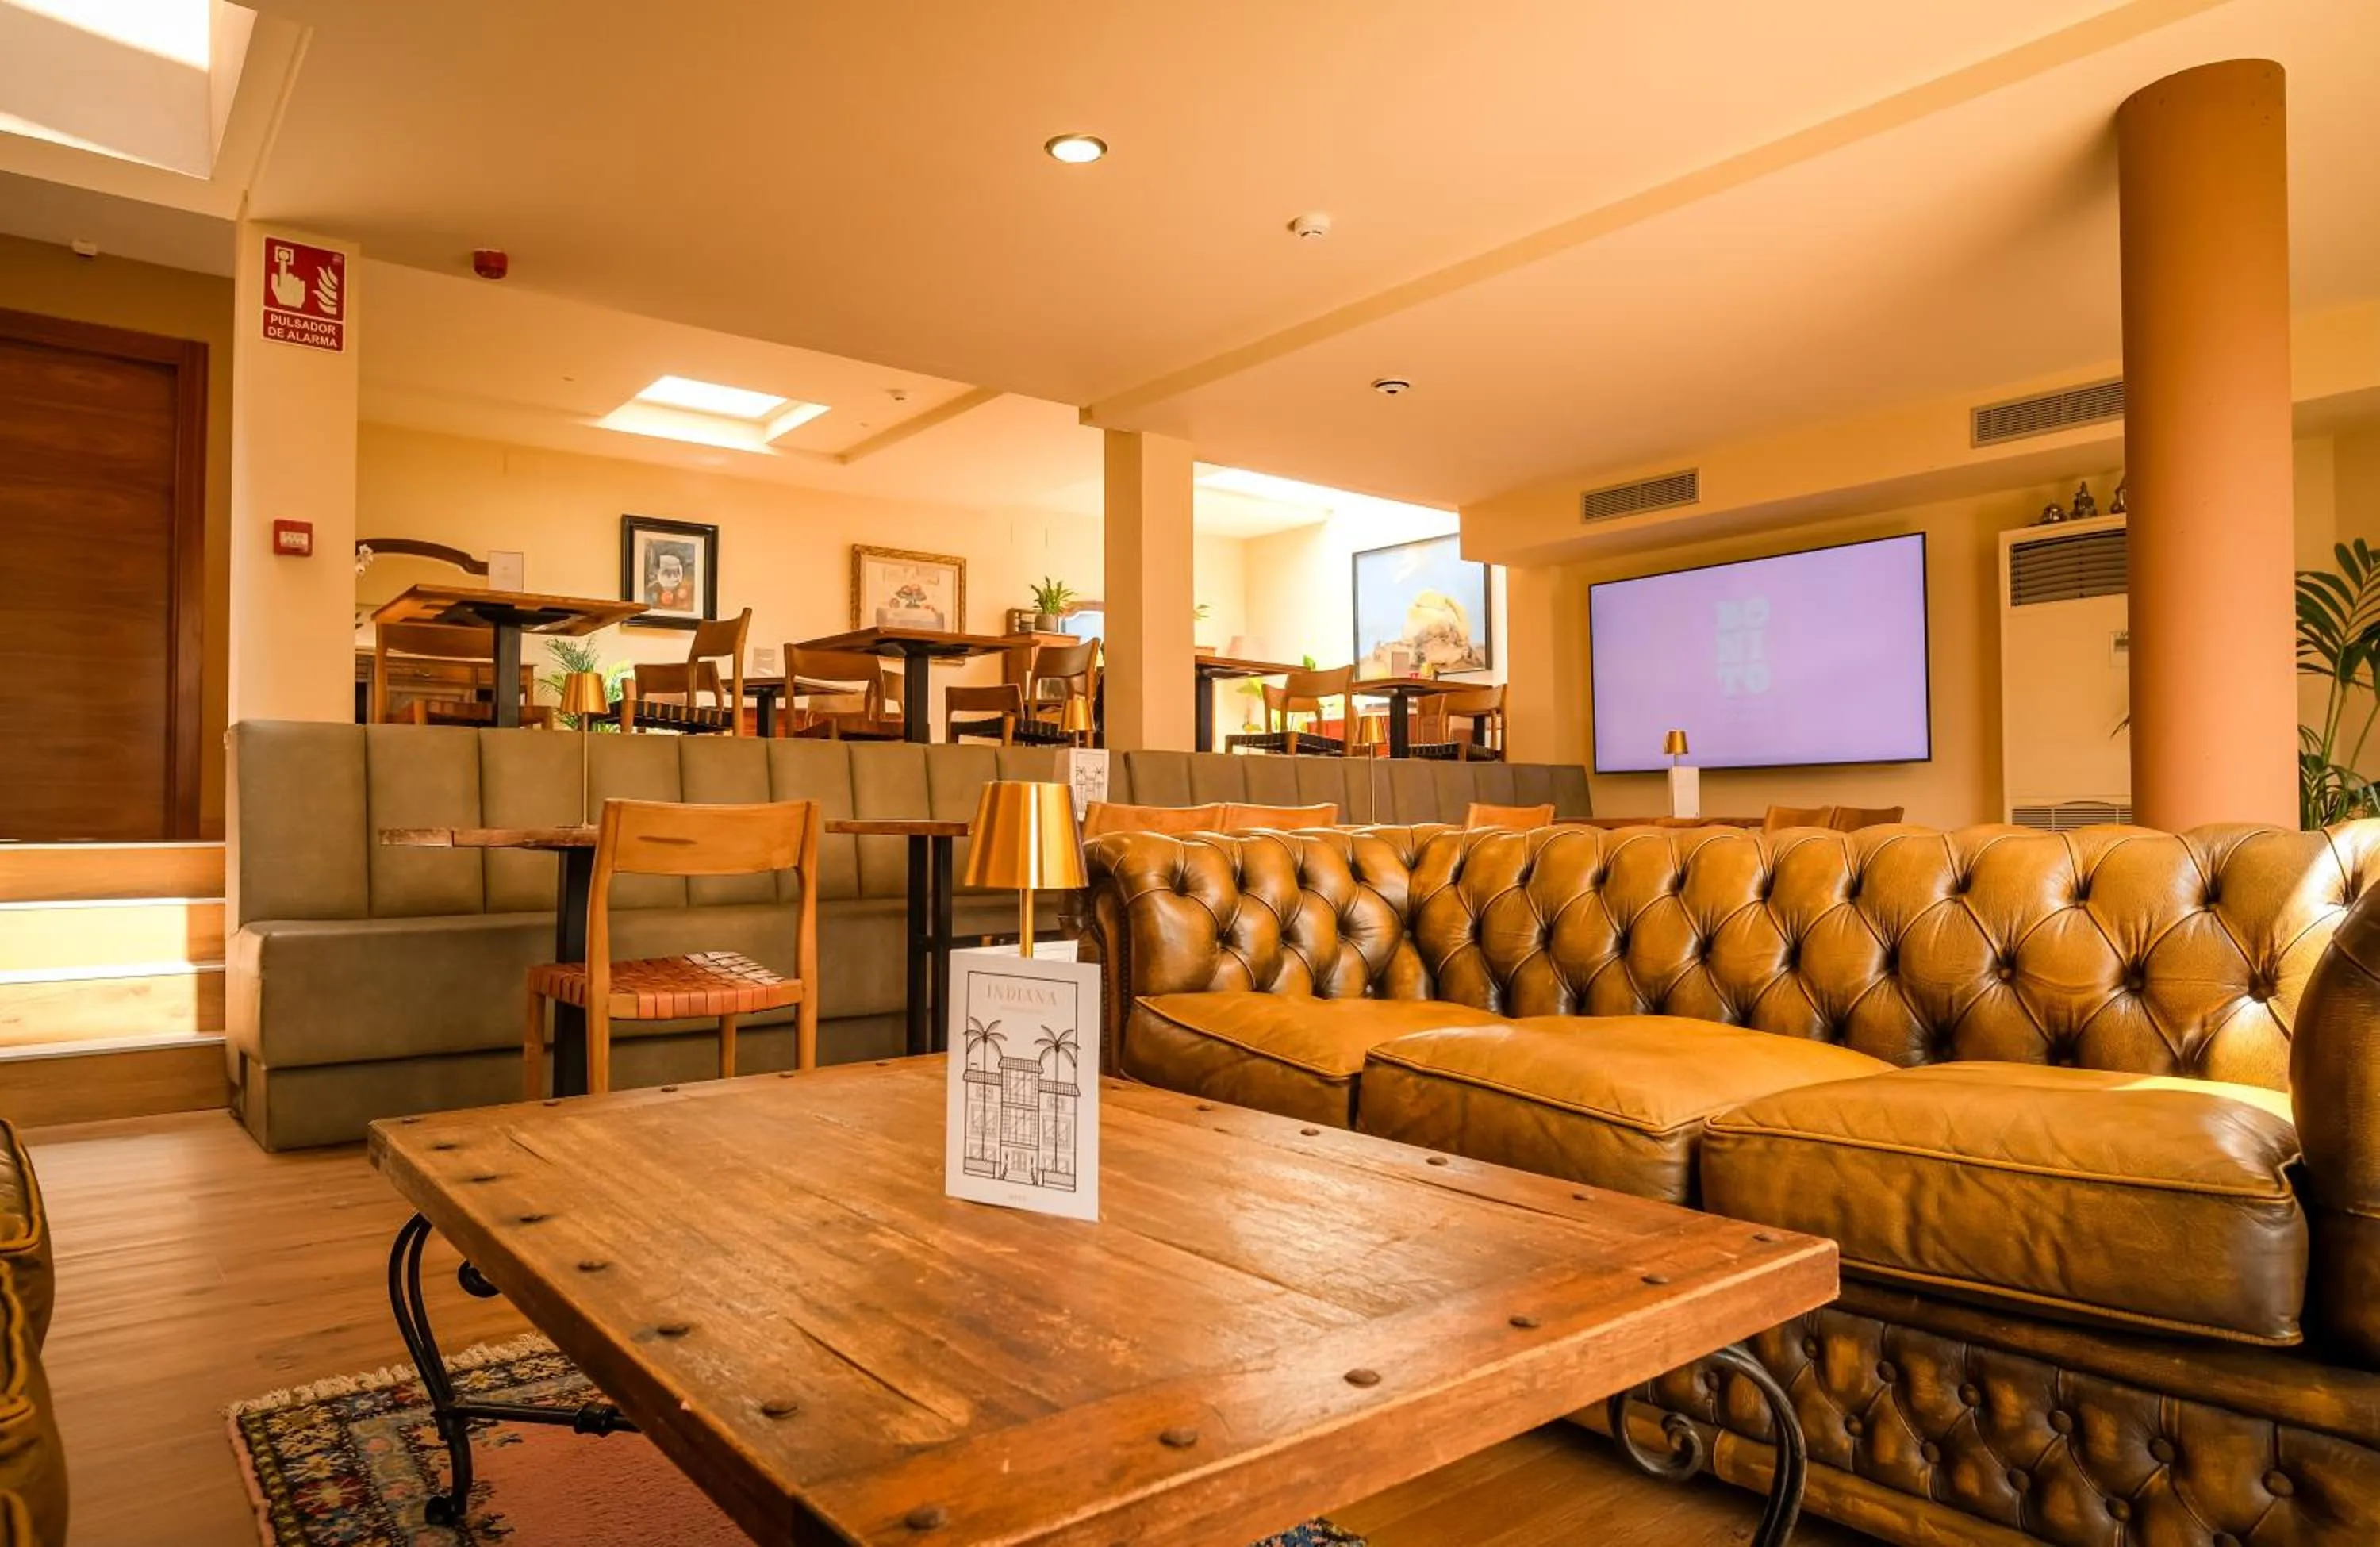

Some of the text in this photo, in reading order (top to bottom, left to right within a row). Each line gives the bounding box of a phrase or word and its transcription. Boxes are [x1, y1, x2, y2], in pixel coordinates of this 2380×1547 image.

[270, 313, 336, 335] PULSADOR
[267, 326, 338, 347] DE ALARMA
[986, 982, 1058, 1007] INDIANA
